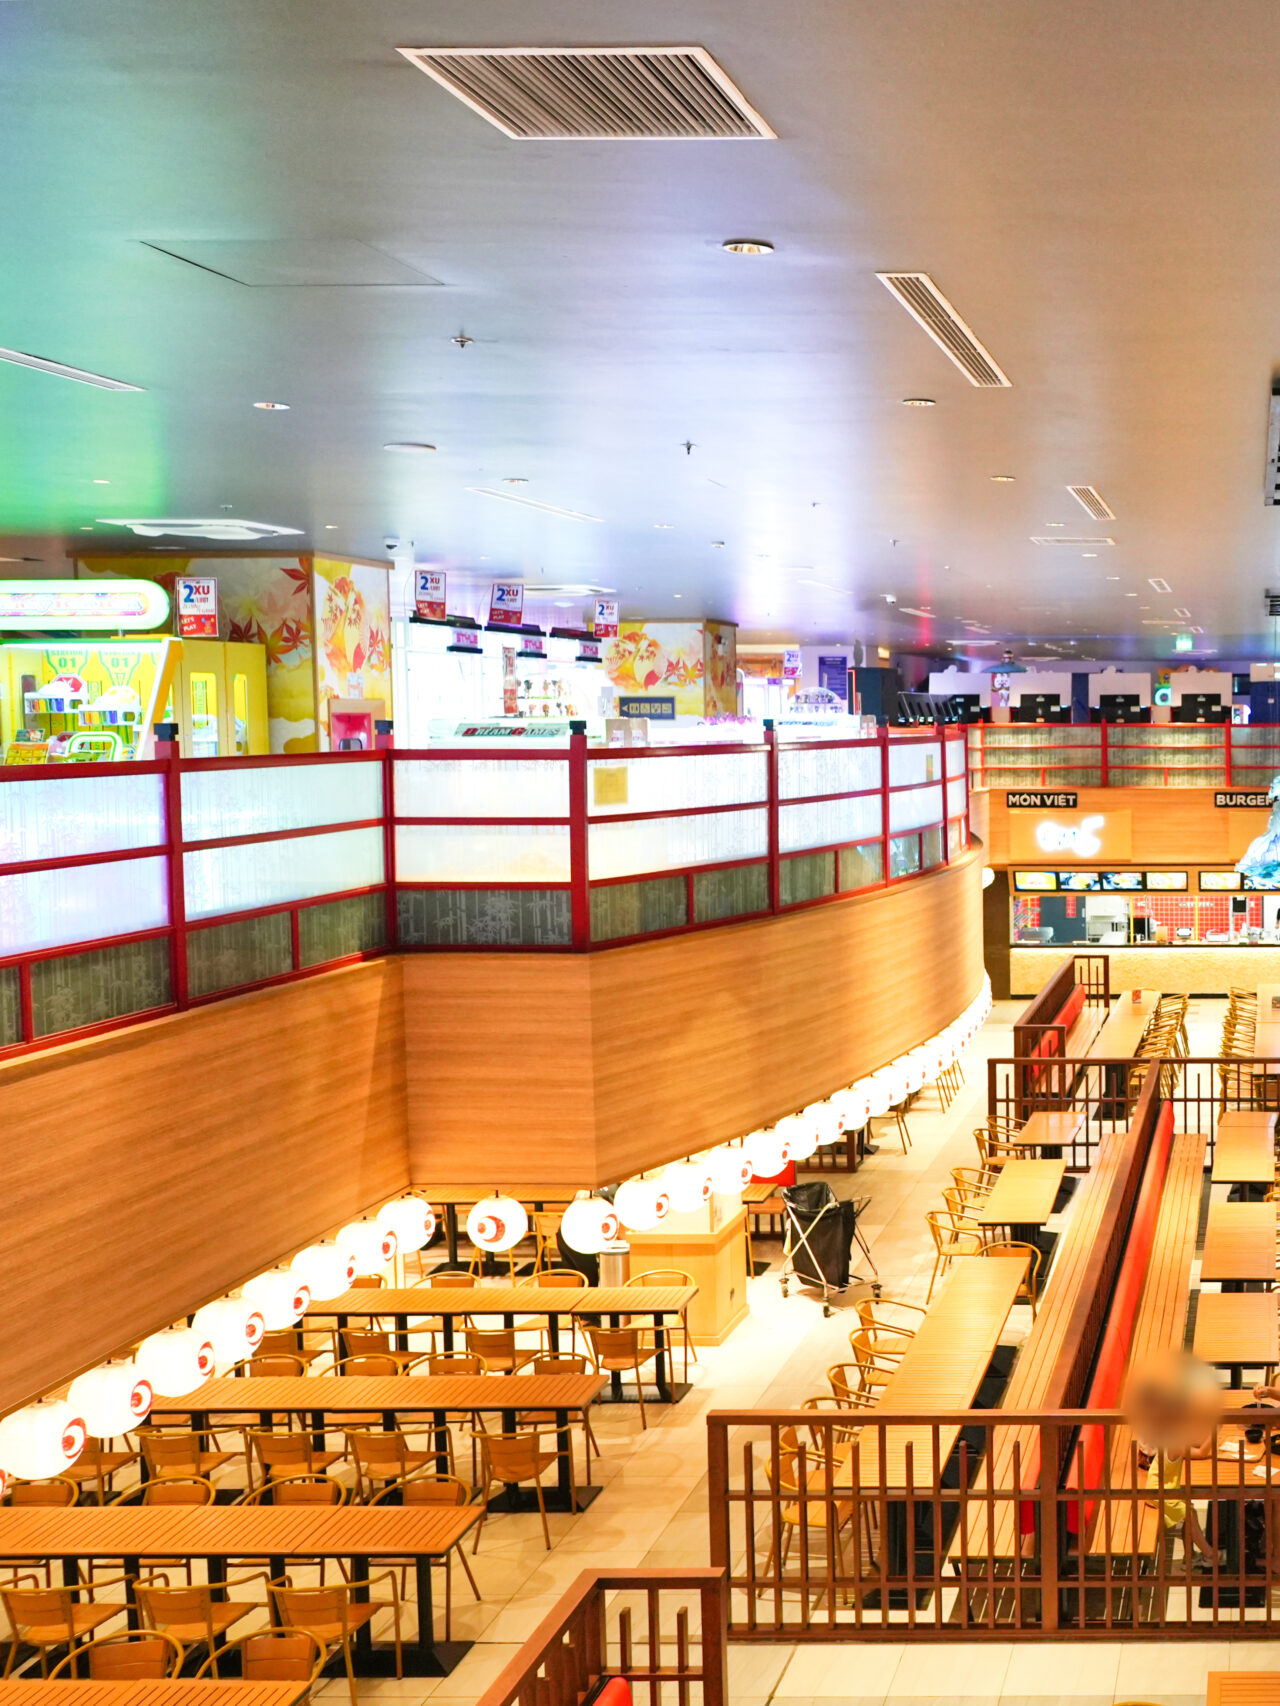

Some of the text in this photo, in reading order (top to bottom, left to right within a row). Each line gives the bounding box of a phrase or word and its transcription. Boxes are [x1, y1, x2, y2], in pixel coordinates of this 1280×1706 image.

[420, 575, 429, 591] 2
[183, 584, 210, 603] 2 XU
[496, 587, 518, 601] 2 XU
[599, 604, 605, 616] 2
[456, 633, 478, 644] STYLE
[58, 657, 77, 668] 01
[111, 657, 129, 668] 01
